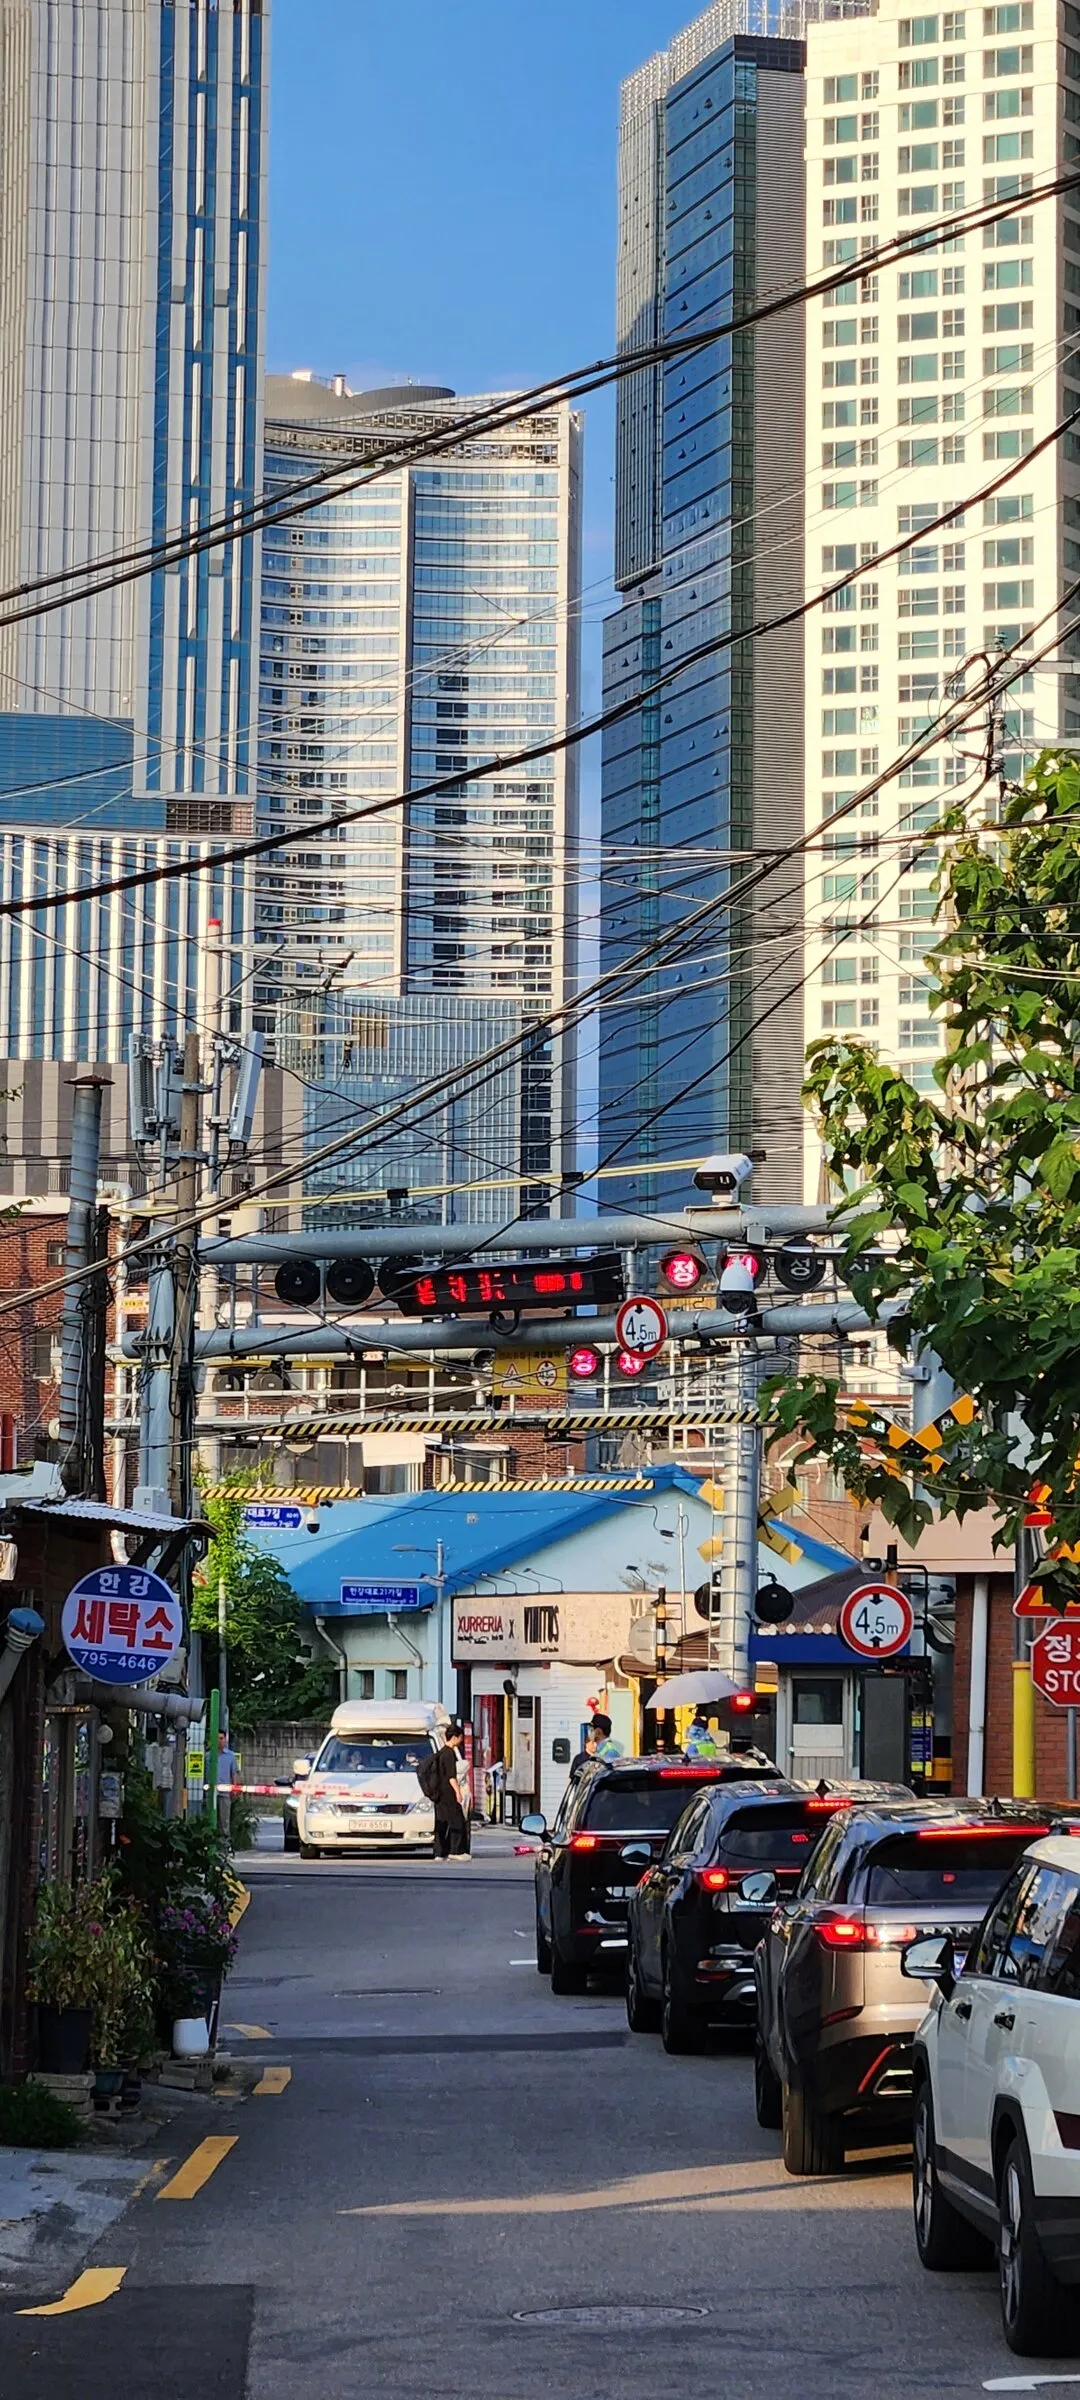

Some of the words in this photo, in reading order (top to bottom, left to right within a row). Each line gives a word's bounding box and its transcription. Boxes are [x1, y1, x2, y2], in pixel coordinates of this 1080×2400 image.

[626, 1315, 657, 1341] 4.5m
[70, 1599, 174, 1651] 세탁소
[457, 1616, 503, 1633] XURRERIA
[855, 1606, 899, 1635] 4.5m
[80, 1651, 157, 1671] 795-4646
[1043, 1634, 1080, 1663] 정
